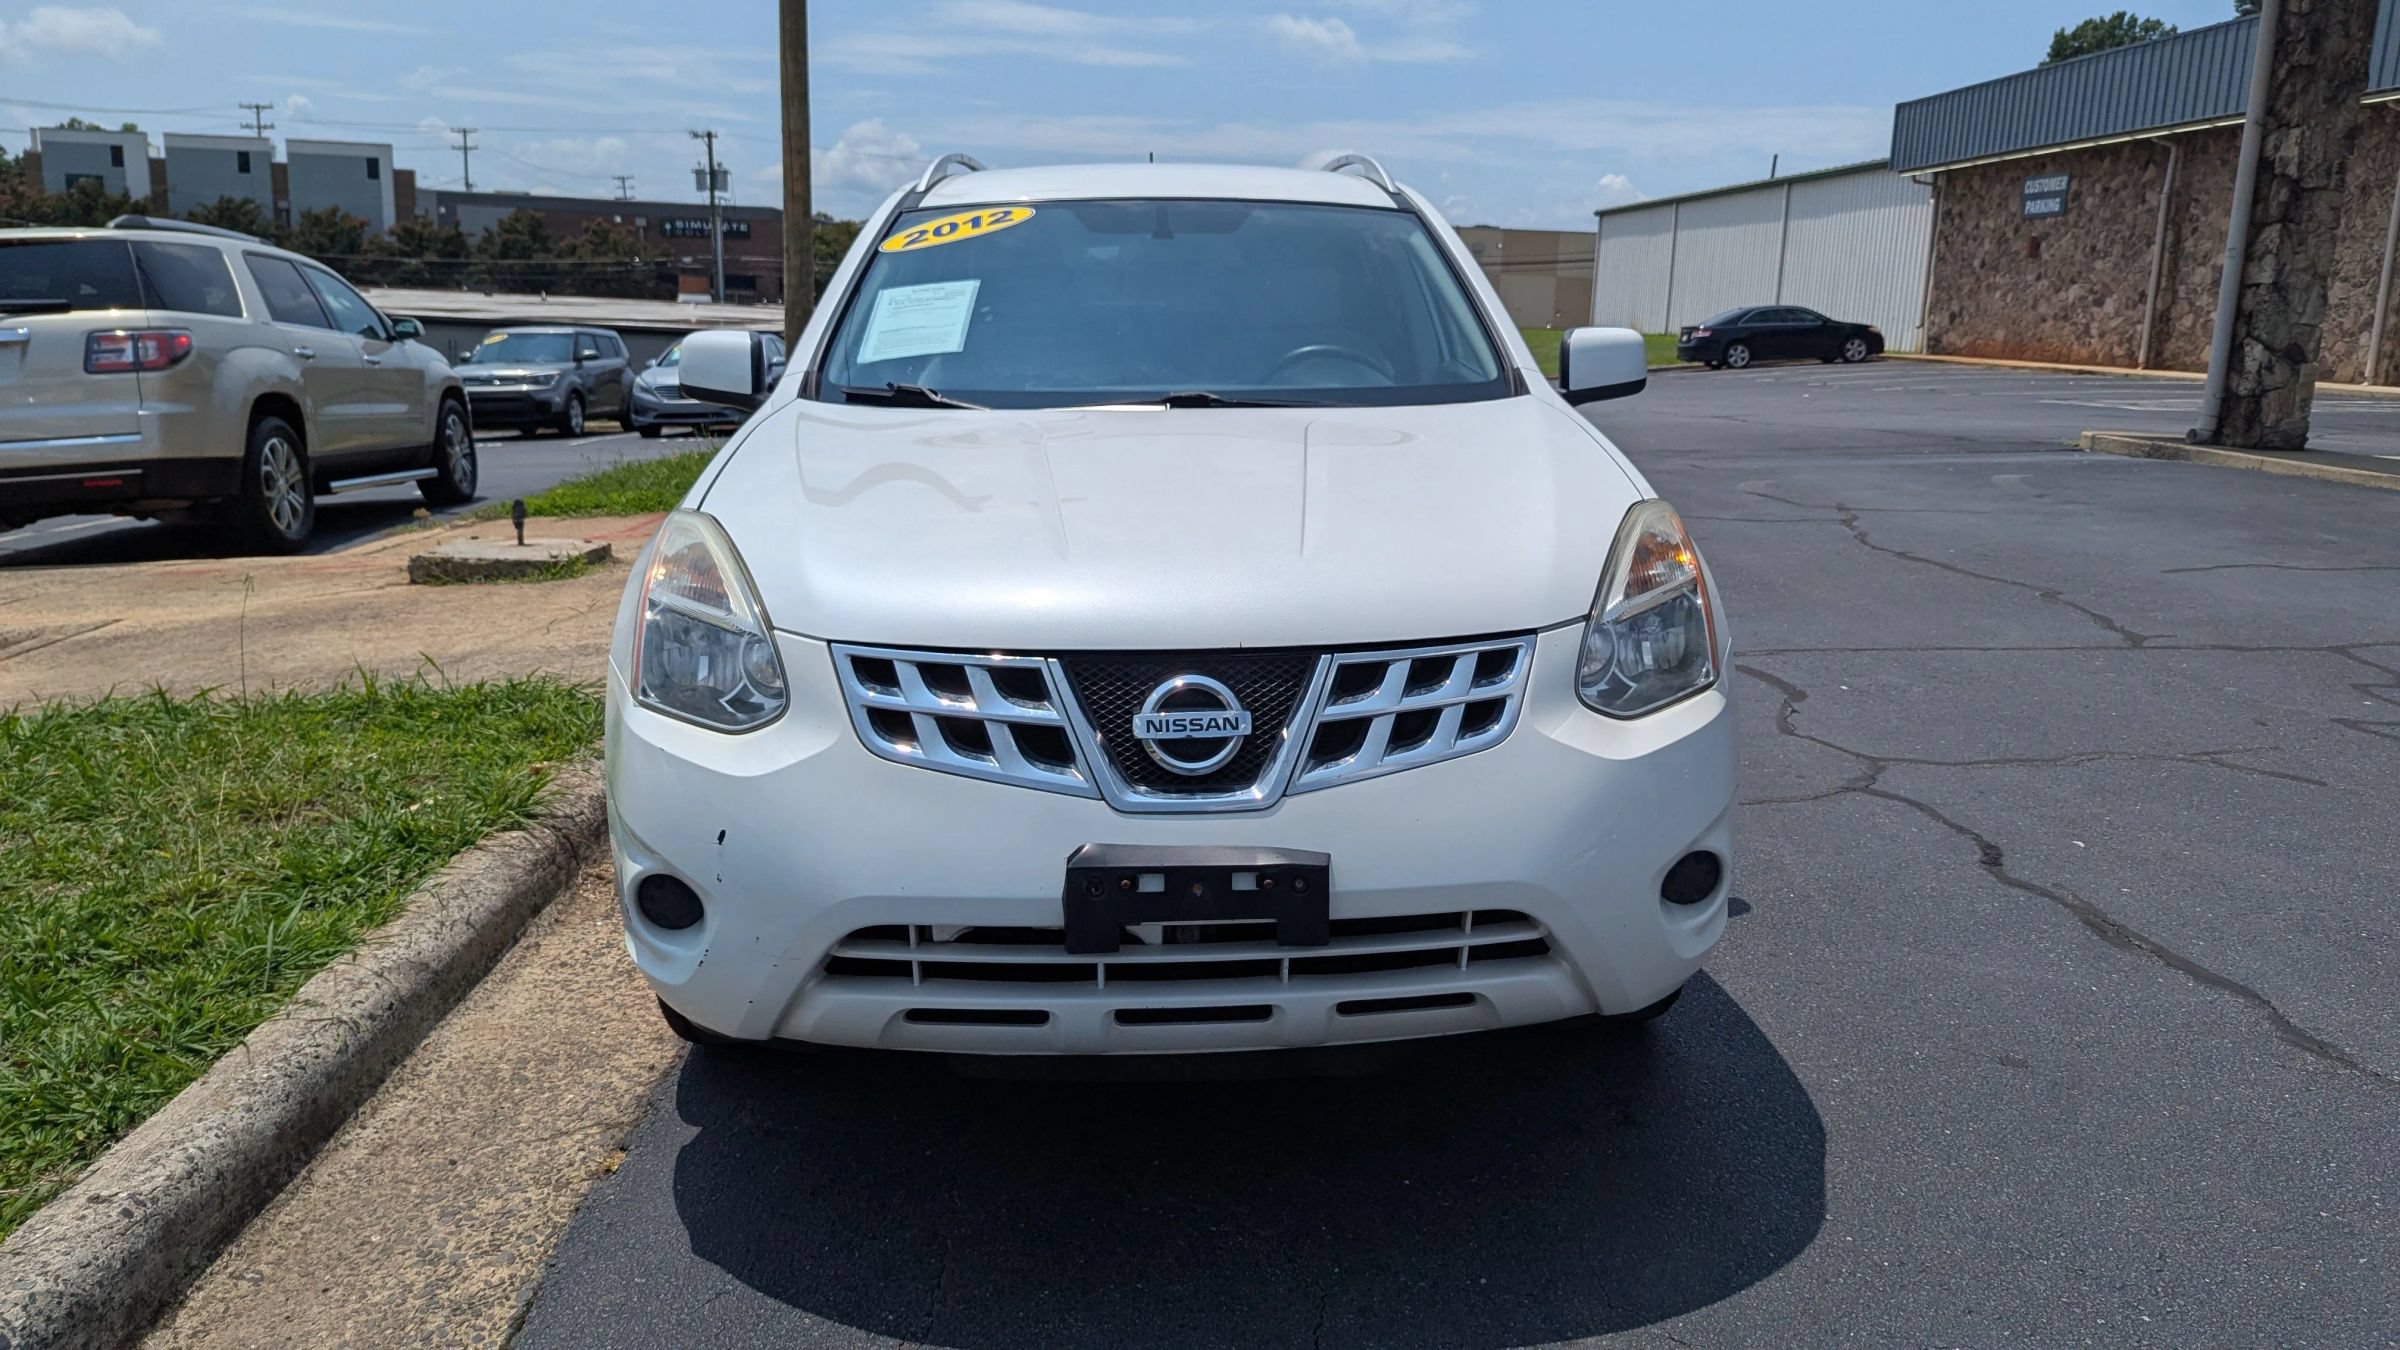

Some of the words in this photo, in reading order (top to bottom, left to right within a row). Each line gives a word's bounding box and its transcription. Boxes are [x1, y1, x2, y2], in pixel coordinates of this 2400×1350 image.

[2024, 176, 2068, 194] CUSTOMER
[2024, 198, 2061, 215] PARKING
[675, 220, 748, 232] SIMUATE
[902, 210, 1014, 249] 2012
[1146, 716, 1240, 733] NISSAN
